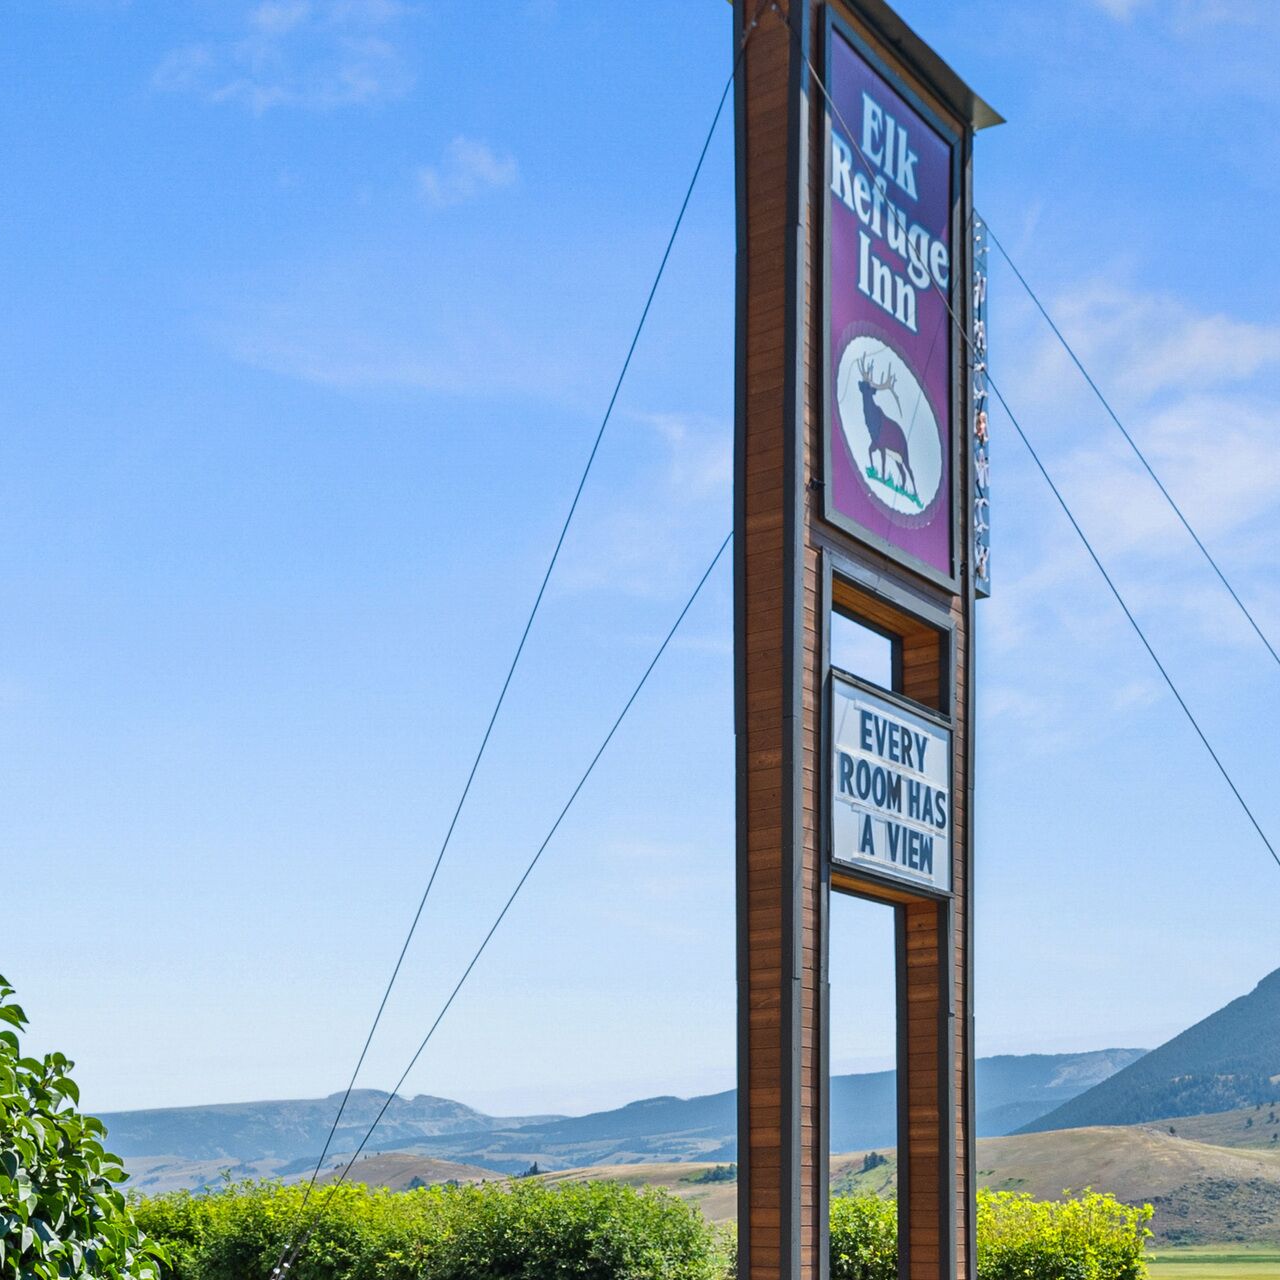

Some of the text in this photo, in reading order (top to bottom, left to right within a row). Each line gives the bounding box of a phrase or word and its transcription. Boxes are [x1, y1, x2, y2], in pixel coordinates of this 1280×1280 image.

[861, 93, 918, 199] Elk
[831, 134, 949, 289] Refuge
[858, 231, 917, 332] Inn
[861, 710, 928, 773] EVERY
[839, 752, 946, 829] ROOM HAS
[861, 814, 933, 875] A VIEW
